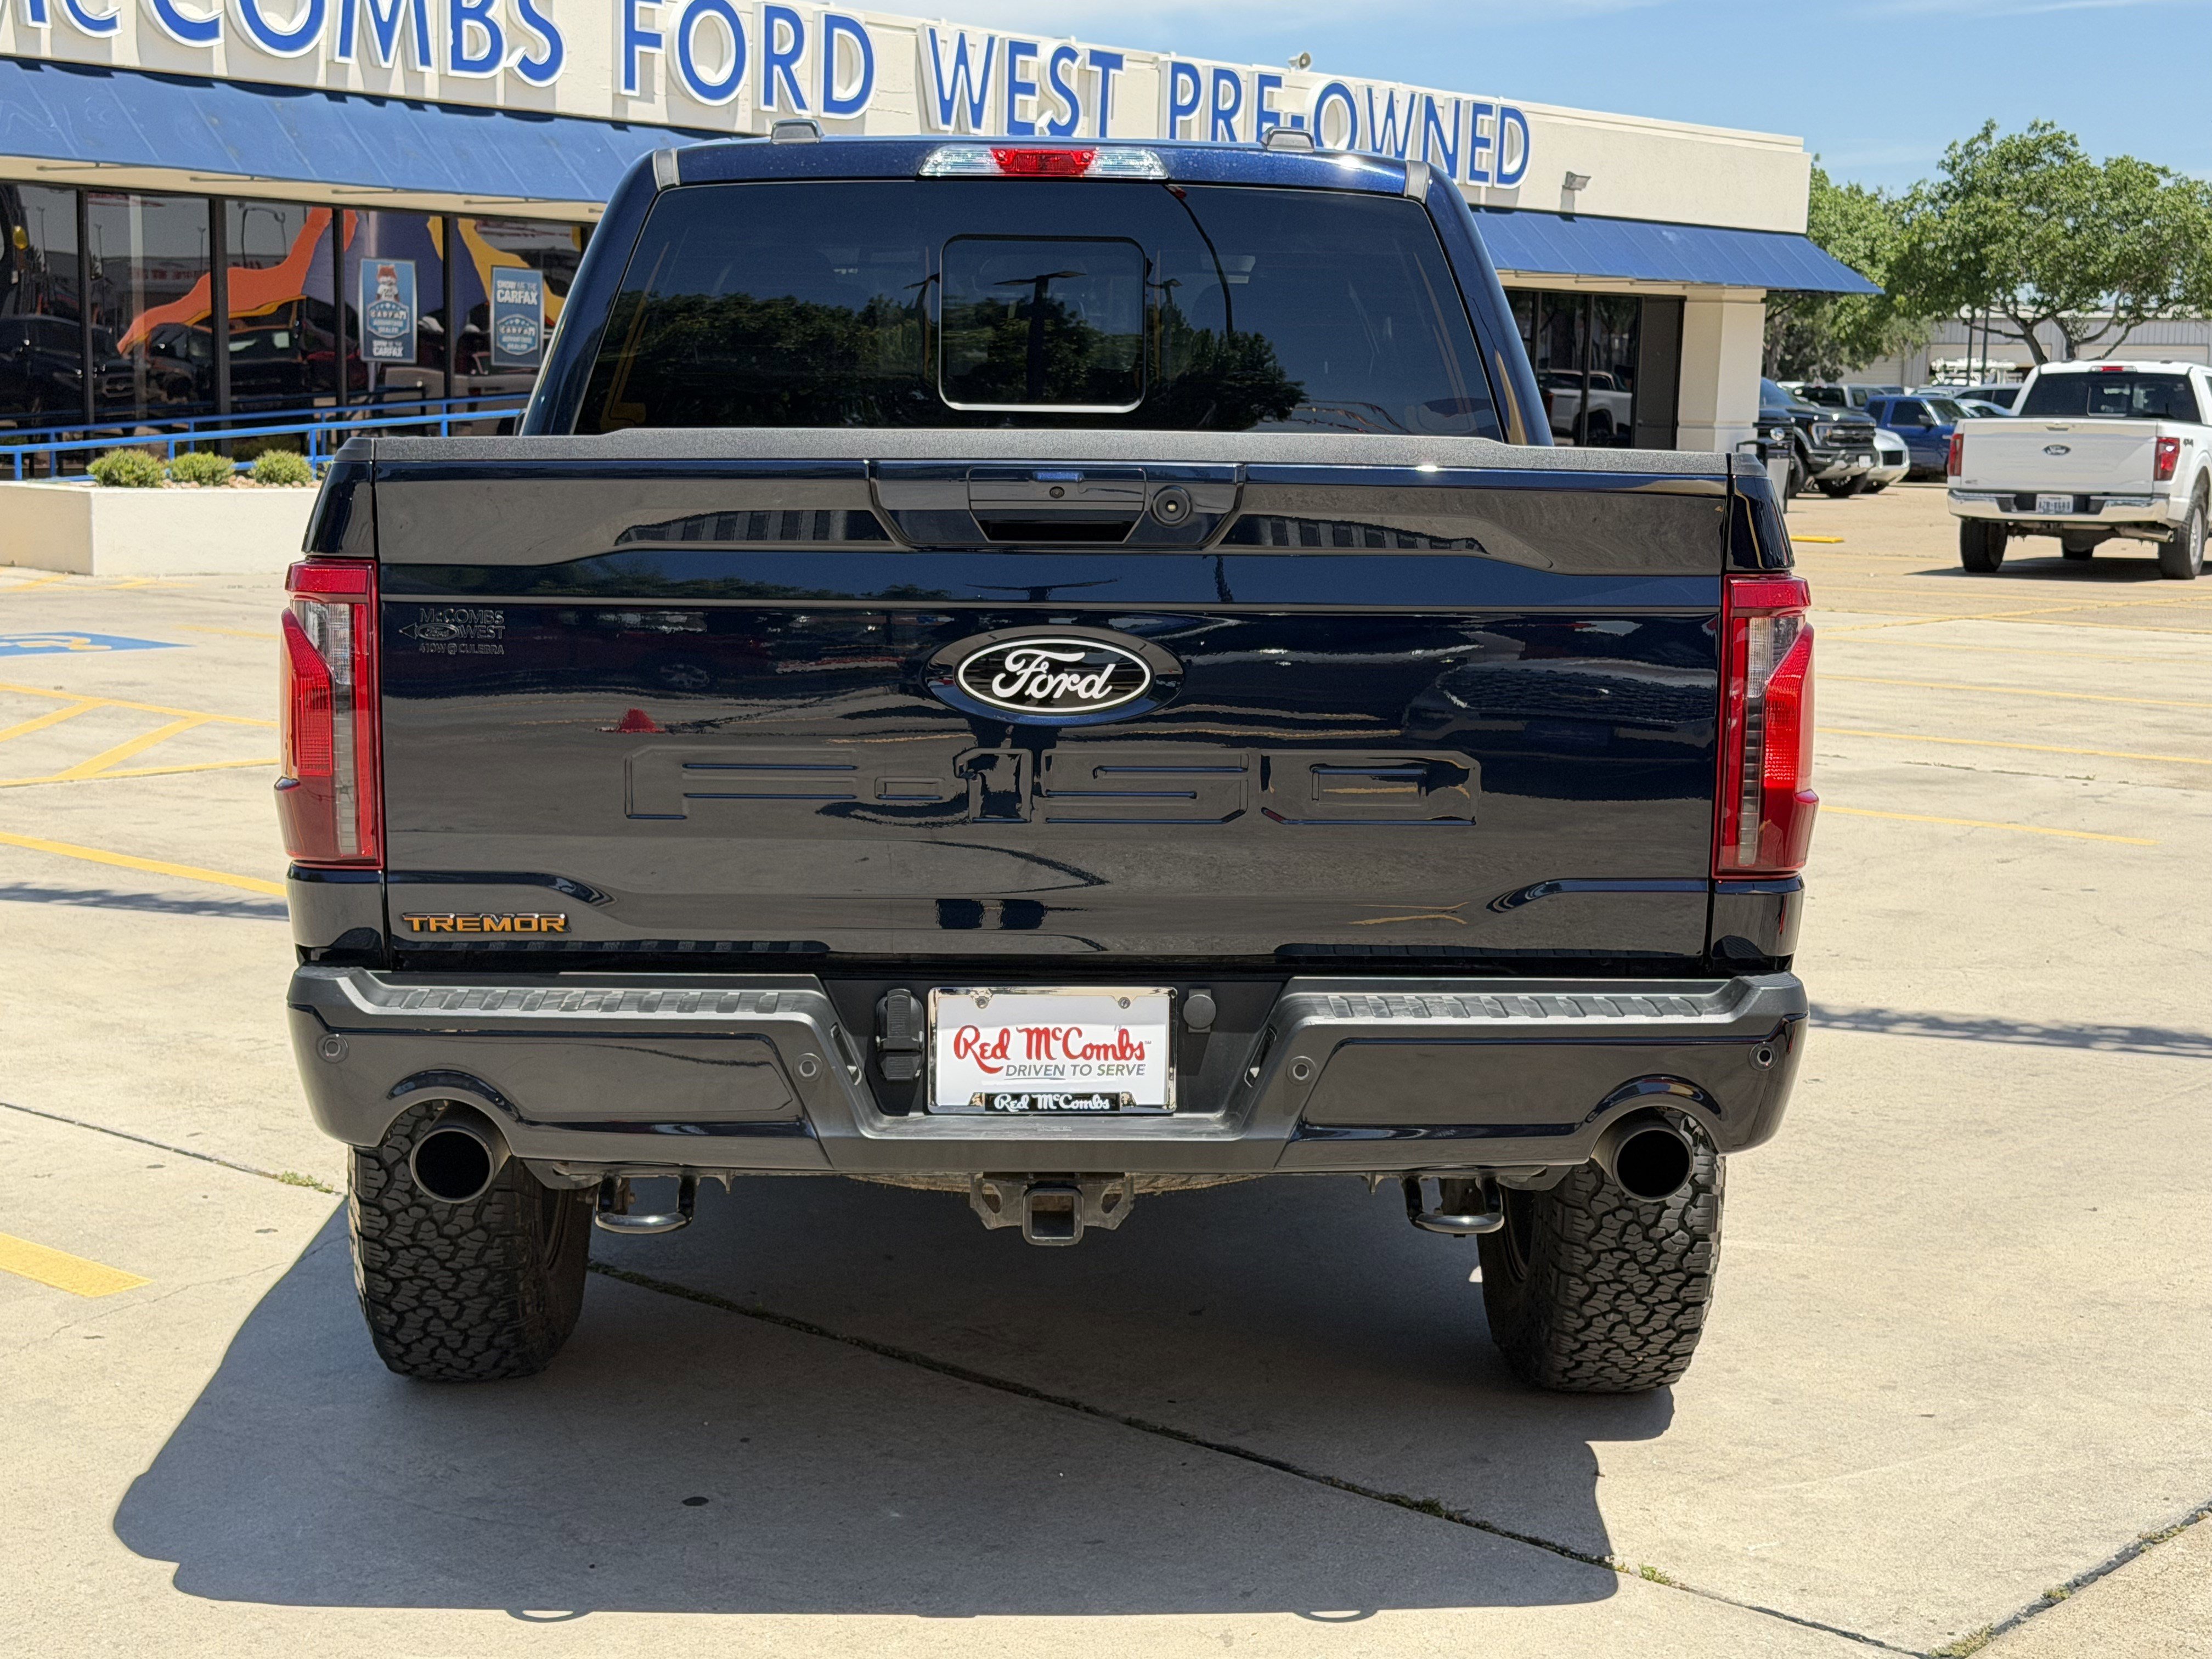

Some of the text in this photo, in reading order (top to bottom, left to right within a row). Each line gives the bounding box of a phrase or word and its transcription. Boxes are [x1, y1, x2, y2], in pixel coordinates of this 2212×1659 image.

[619, 0, 877, 119] FORD
[924, 24, 1125, 137] WEST
[1166, 60, 1531, 188] PRE-OWNED
[496, 290, 538, 305] CARFAX
[992, 649, 1116, 698] Ford
[403, 913, 567, 932] TREMOR
[953, 1025, 1011, 1074] Red
[1016, 1026, 1145, 1060] McCombs
[1005, 1063, 1146, 1076] DRIVEN TO SERVE
[994, 1093, 1110, 1113] Red McCombs
